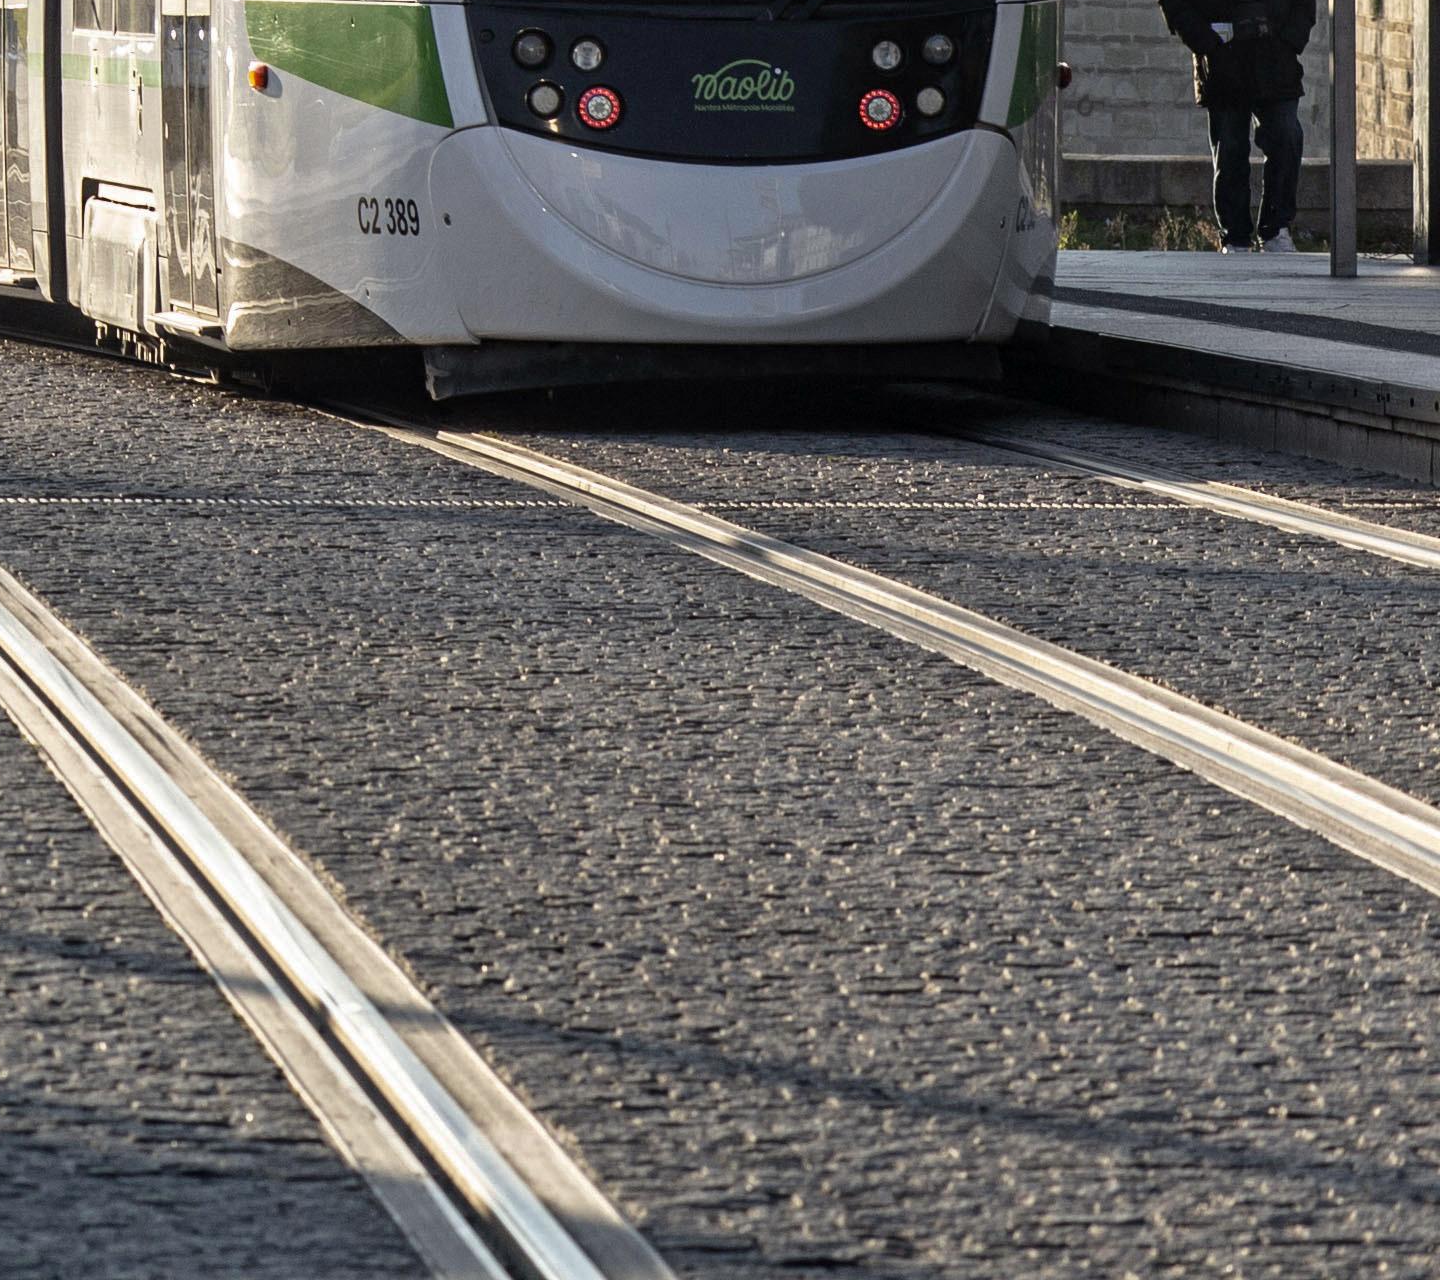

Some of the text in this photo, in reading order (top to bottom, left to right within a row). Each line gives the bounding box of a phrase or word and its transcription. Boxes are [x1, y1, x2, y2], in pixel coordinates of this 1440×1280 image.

[692, 59, 795, 101] naolib
[358, 196, 419, 236] C2 389
